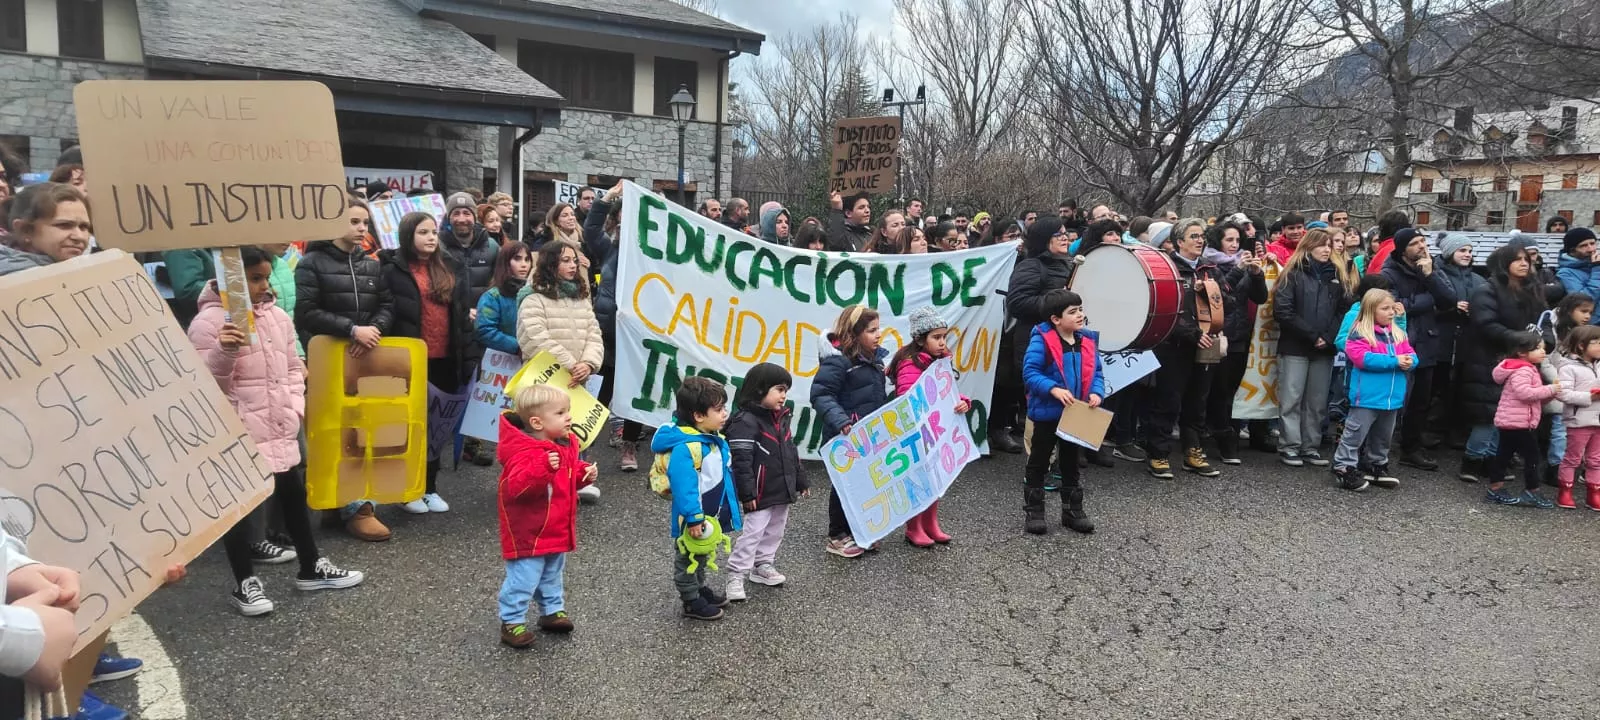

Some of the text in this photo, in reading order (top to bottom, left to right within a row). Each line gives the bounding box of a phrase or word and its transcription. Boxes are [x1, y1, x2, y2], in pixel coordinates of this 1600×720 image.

[100, 94, 257, 121] UN VALLE
[838, 124, 896, 144] INSTITUTO
[144, 139, 195, 165] UNA
[831, 174, 881, 192] DEL VALLE
[835, 156, 892, 177] INSTITUTO
[112, 183, 345, 234] UN INSTITUTO
[639, 194, 987, 316] EDUCACIÓN DE
[633, 271, 821, 377] CALIDAD
[36, 364, 103, 442] SE
[829, 362, 953, 473] QUEREMOS
[861, 425, 971, 533] JUNTOS
[868, 410, 946, 489] ESTAR
[141, 496, 192, 557] SU
[186, 433, 274, 519] GENTE
